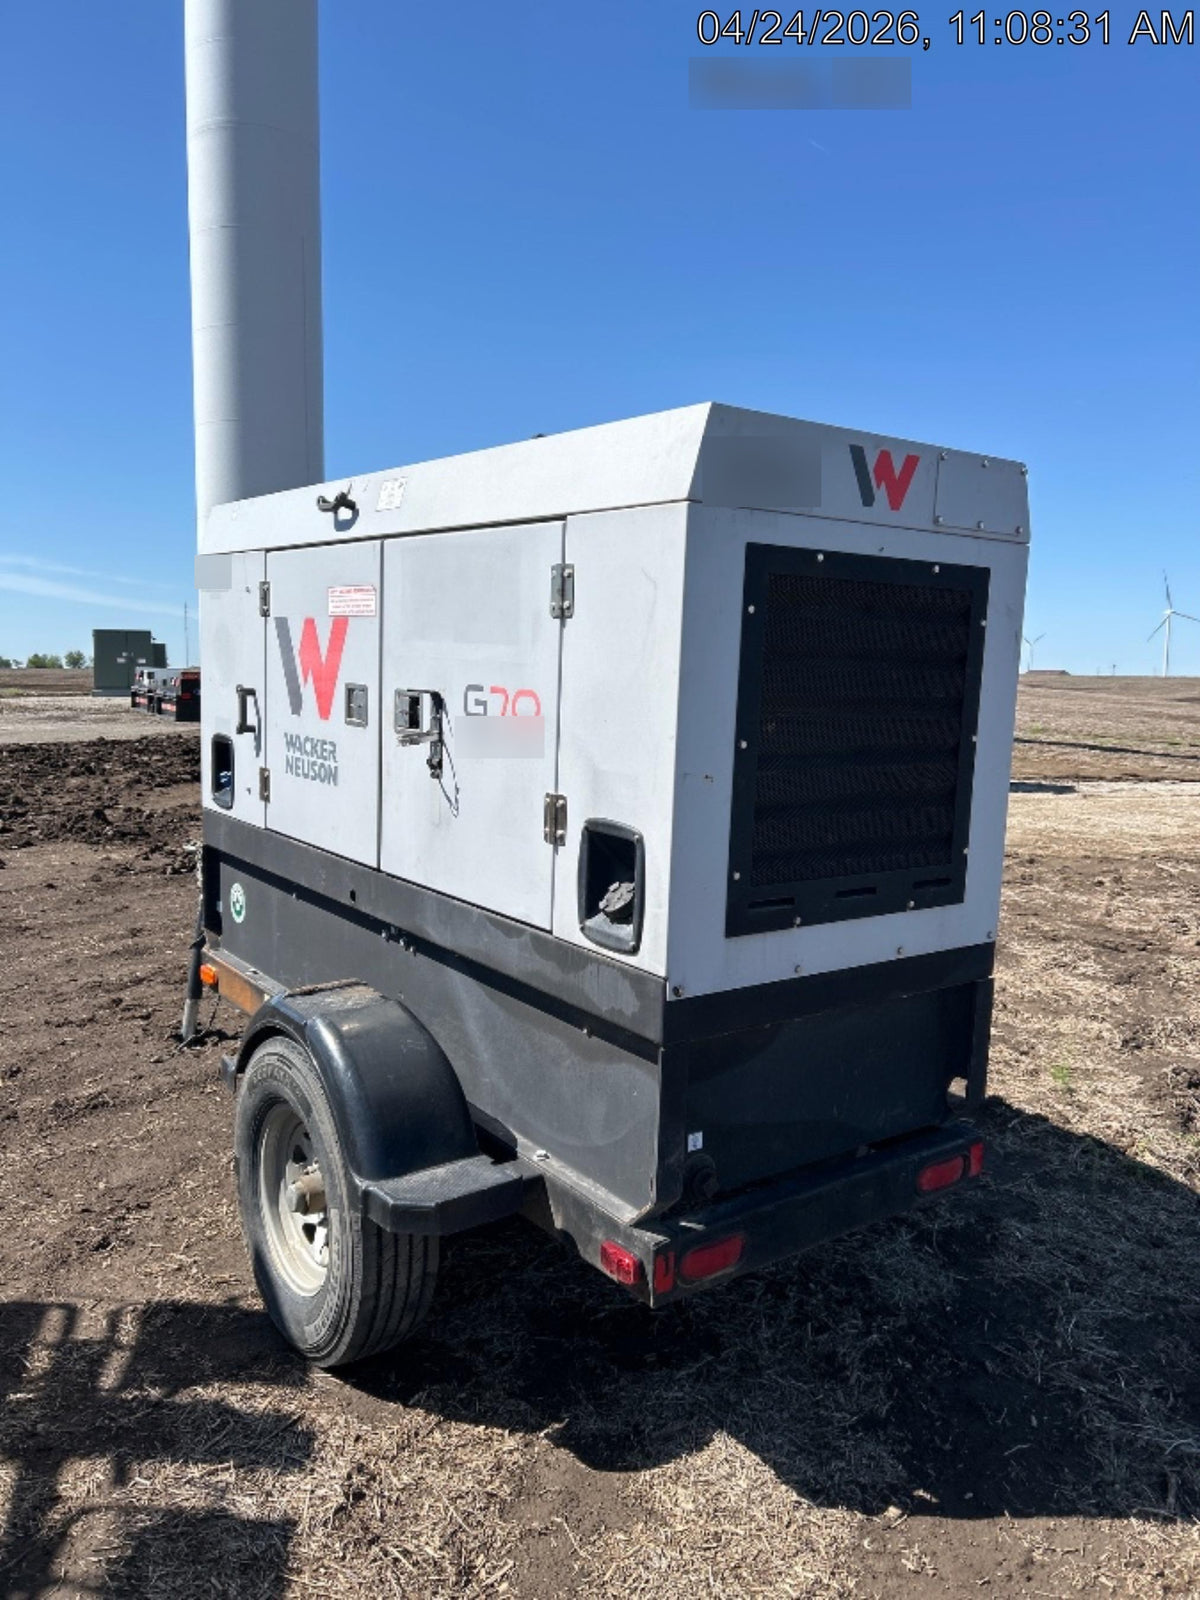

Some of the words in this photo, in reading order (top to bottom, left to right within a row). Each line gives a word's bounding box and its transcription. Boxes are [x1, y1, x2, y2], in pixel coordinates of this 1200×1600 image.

[463, 683, 542, 717] G70
[284, 732, 338, 763] WACKER
[285, 755, 339, 787] NEUSON
